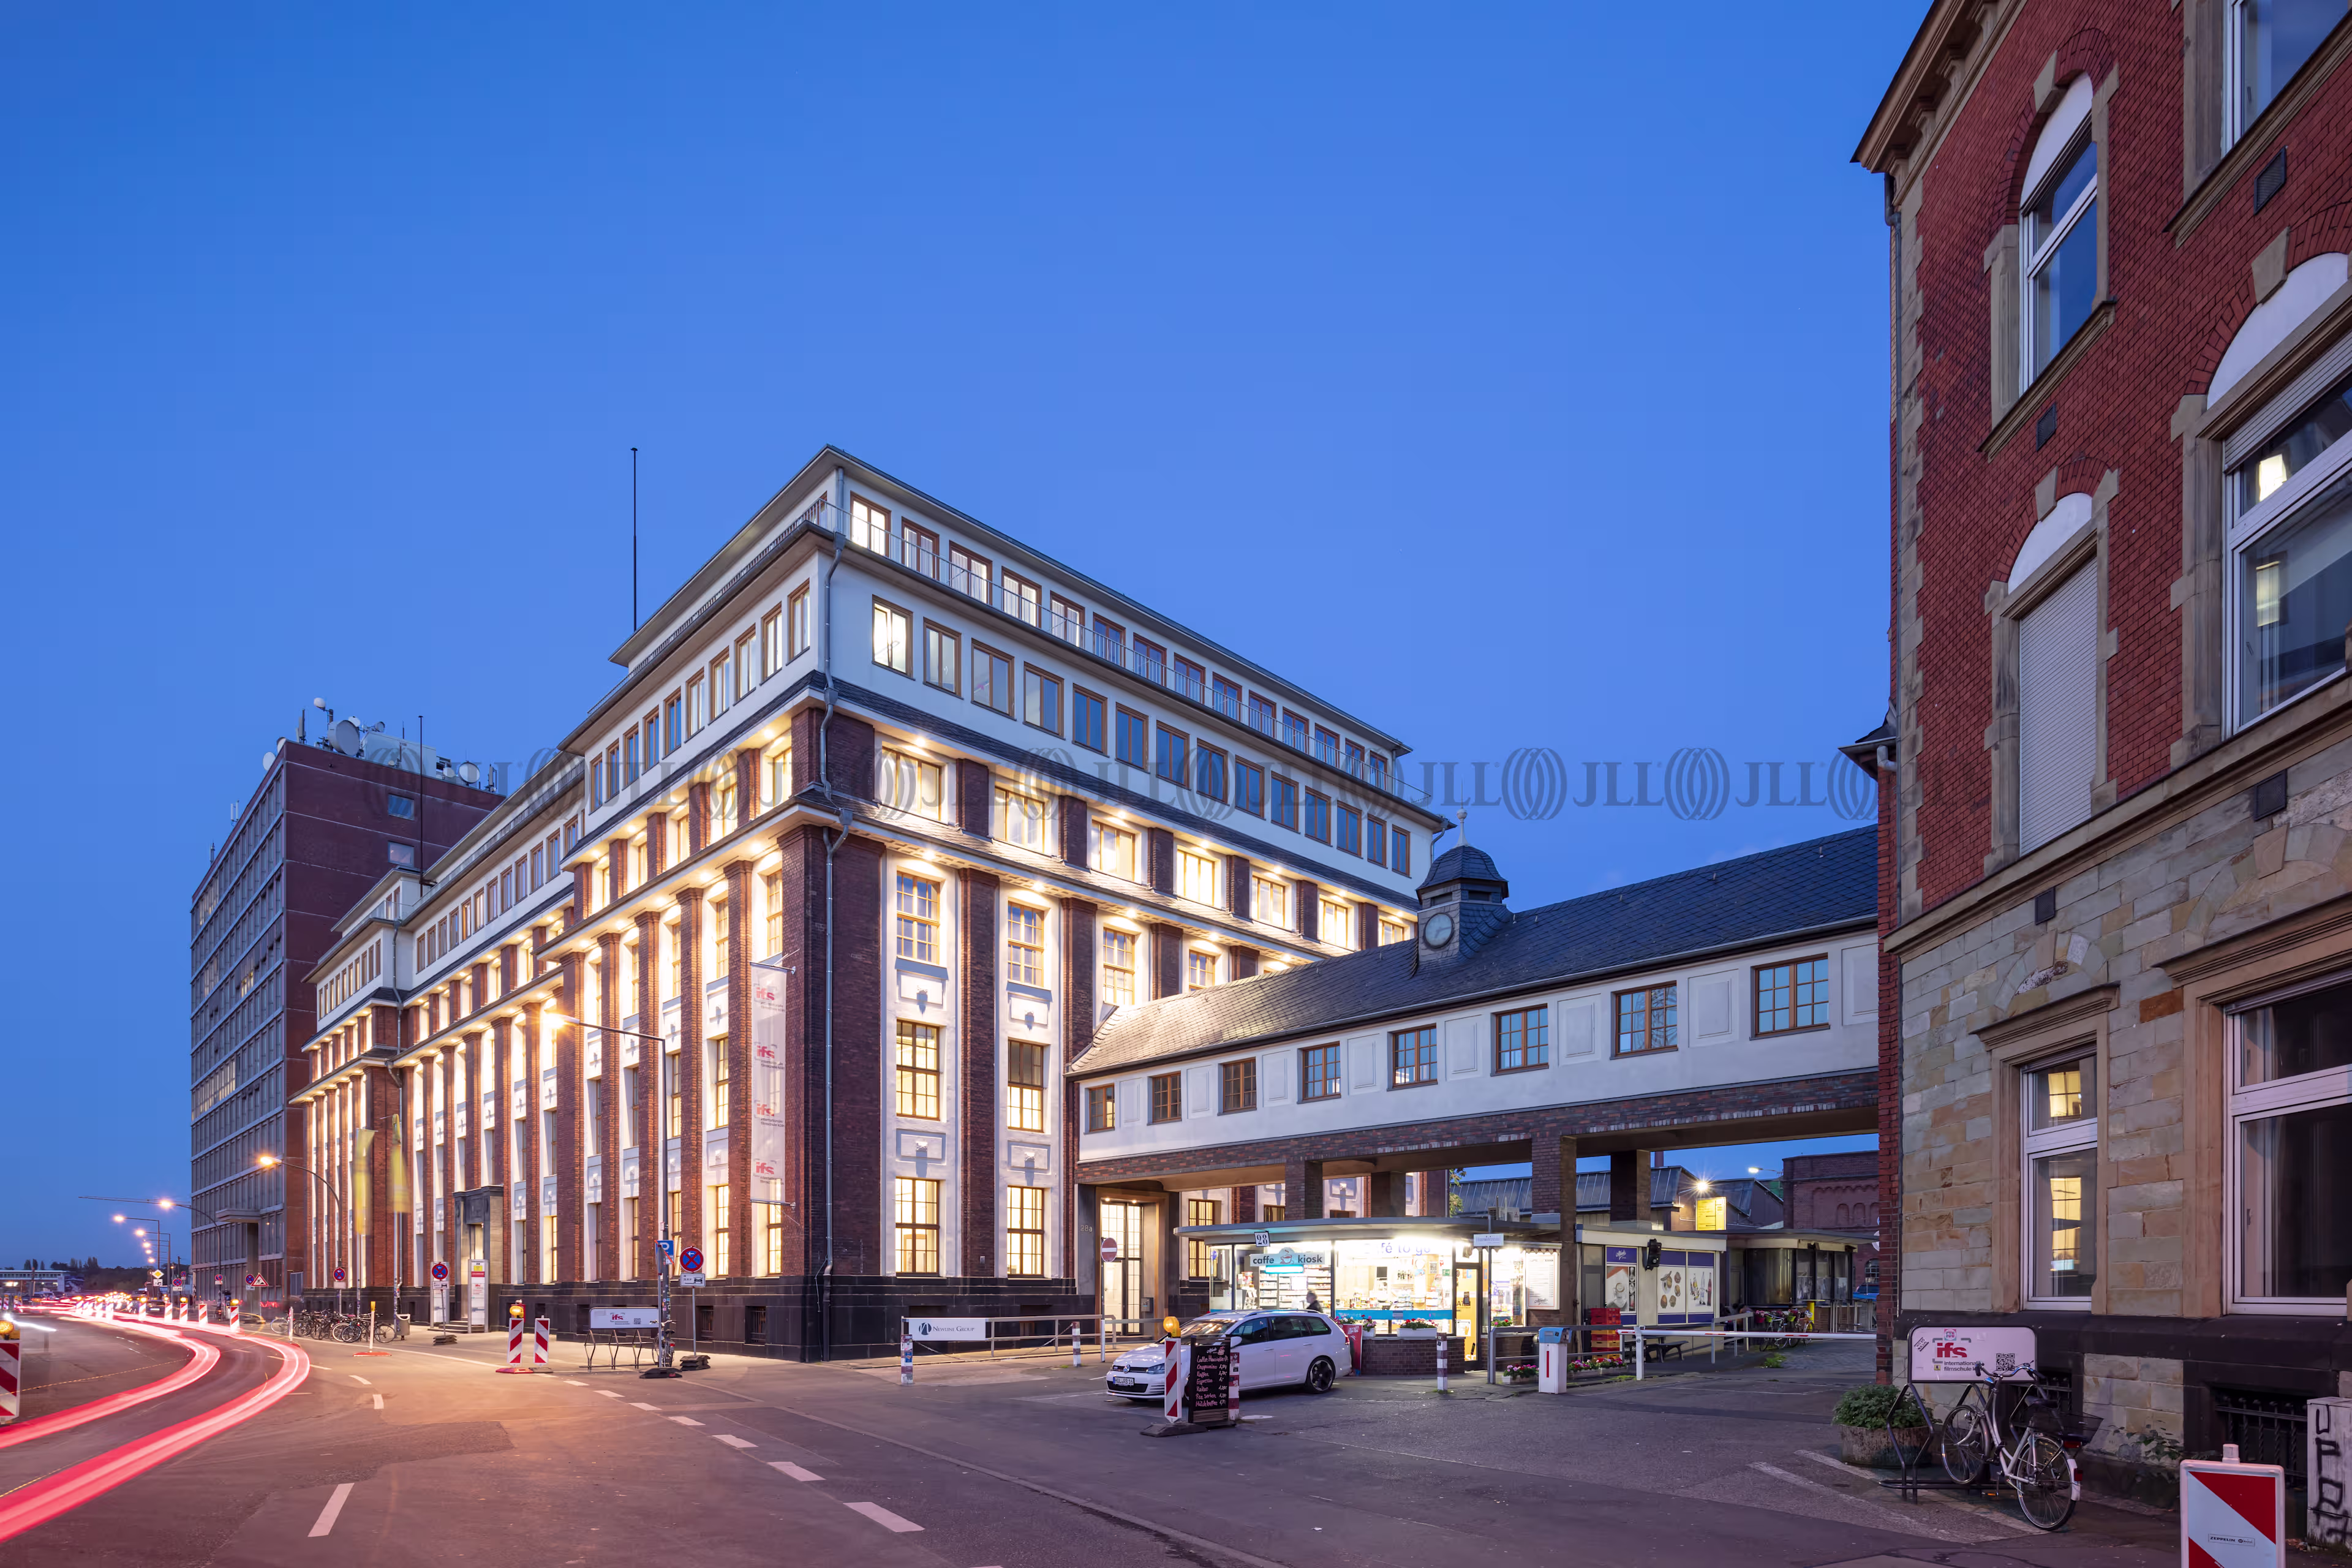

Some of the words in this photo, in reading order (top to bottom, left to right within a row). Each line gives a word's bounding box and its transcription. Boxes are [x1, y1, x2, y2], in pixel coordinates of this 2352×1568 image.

[756, 987, 775, 1000] ifs
[756, 1045, 775, 1058] ifs
[756, 1103, 775, 1117] ifs
[756, 1161, 775, 1174] ifs
[1257, 1234, 1268, 1245] 28
[1253, 1256, 1275, 1264] caffe
[1298, 1254, 1323, 1263] kiosk
[1937, 1342, 1967, 1358] ifs
